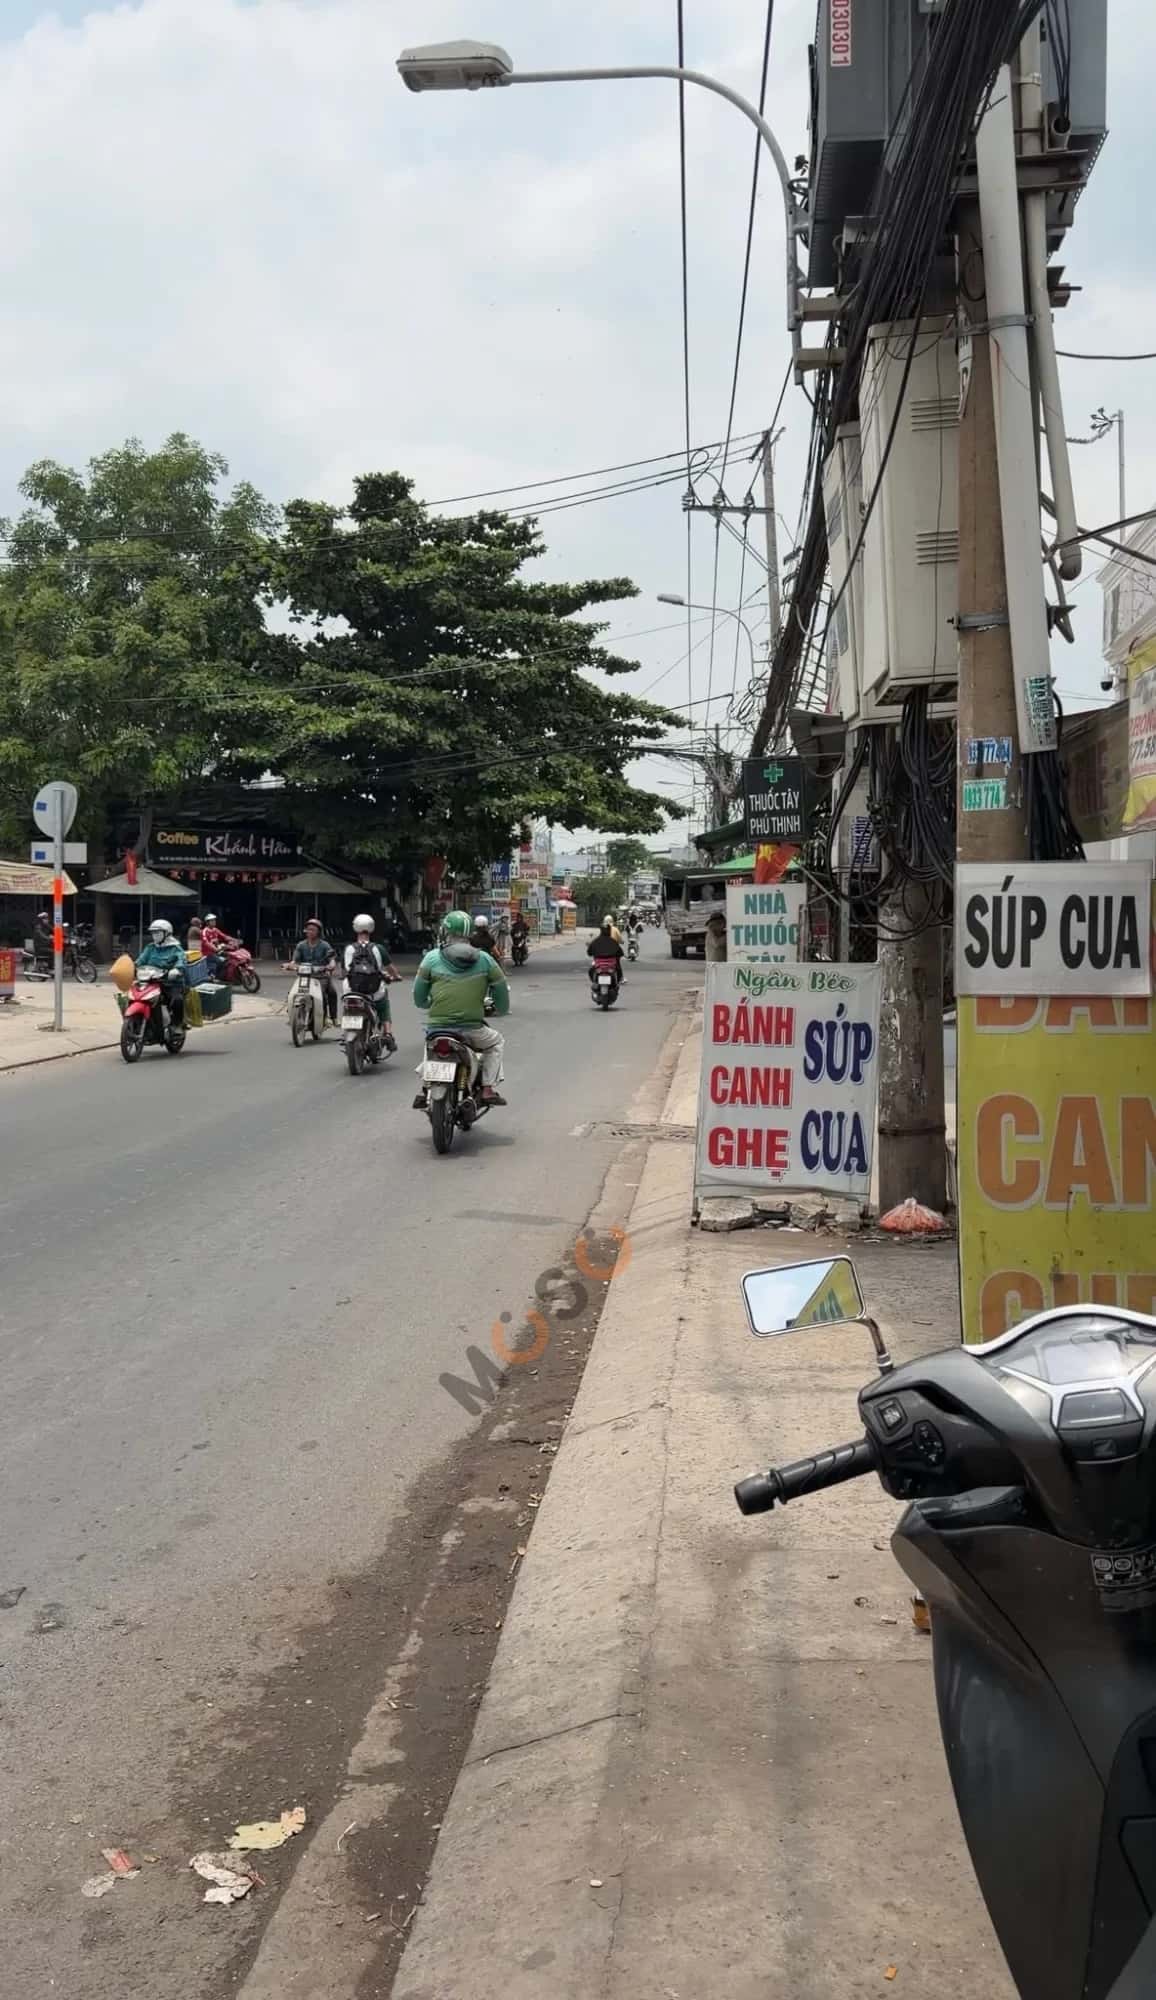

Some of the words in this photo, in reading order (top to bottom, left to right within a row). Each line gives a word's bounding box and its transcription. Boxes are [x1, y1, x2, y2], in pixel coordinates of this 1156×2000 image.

[749, 786, 780, 812] THUỐC
[781, 788, 799, 809] TÂY
[157, 832, 199, 844] Coffee
[750, 814, 769, 835] PHÚ
[771, 815, 800, 836] THỊNH
[206, 833, 256, 855] Khánh
[744, 889, 787, 914] NHÀ
[731, 917, 799, 946] THUỐC
[964, 875, 1047, 969] SÚP
[1060, 894, 1141, 969] CUA
[735, 968, 800, 996] Ngân
[809, 971, 856, 992] Béo
[712, 996, 794, 1045] BÁNH
[803, 1003, 873, 1083] SÚP
[710, 1065, 793, 1107] CANH
[708, 1126, 790, 1178] GHẸ
[801, 1109, 868, 1174] CUA
